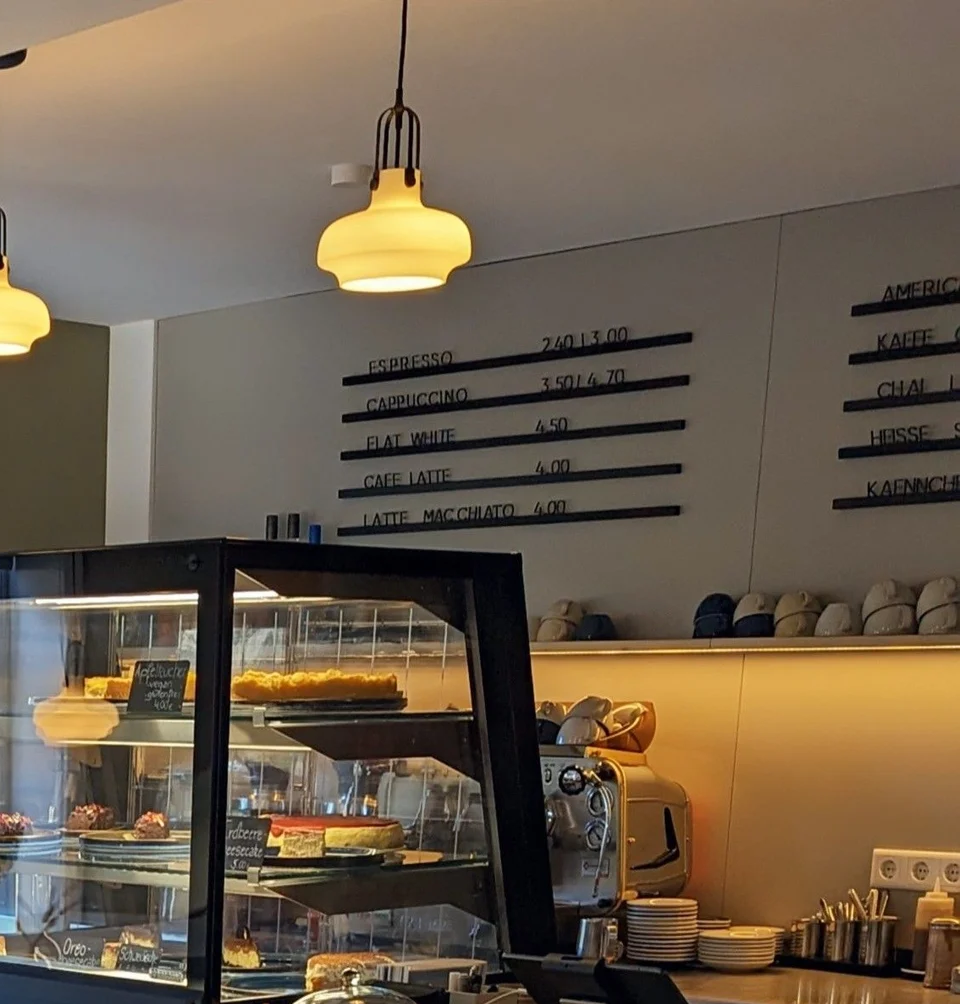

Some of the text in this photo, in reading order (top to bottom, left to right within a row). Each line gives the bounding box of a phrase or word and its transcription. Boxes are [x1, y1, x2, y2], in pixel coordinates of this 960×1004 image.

[882, 277, 960, 302] AMERIC
[369, 351, 453, 375] ESPRESSO
[367, 387, 468, 412] CAPPUCCINO
[367, 434, 401, 451] FLAT
[411, 428, 456, 446] WHITE
[364, 471, 401, 489] CAFE
[408, 468, 452, 486] LATTE
[363, 511, 408, 527] LATTE
[423, 503, 515, 524] MACCHIATO
